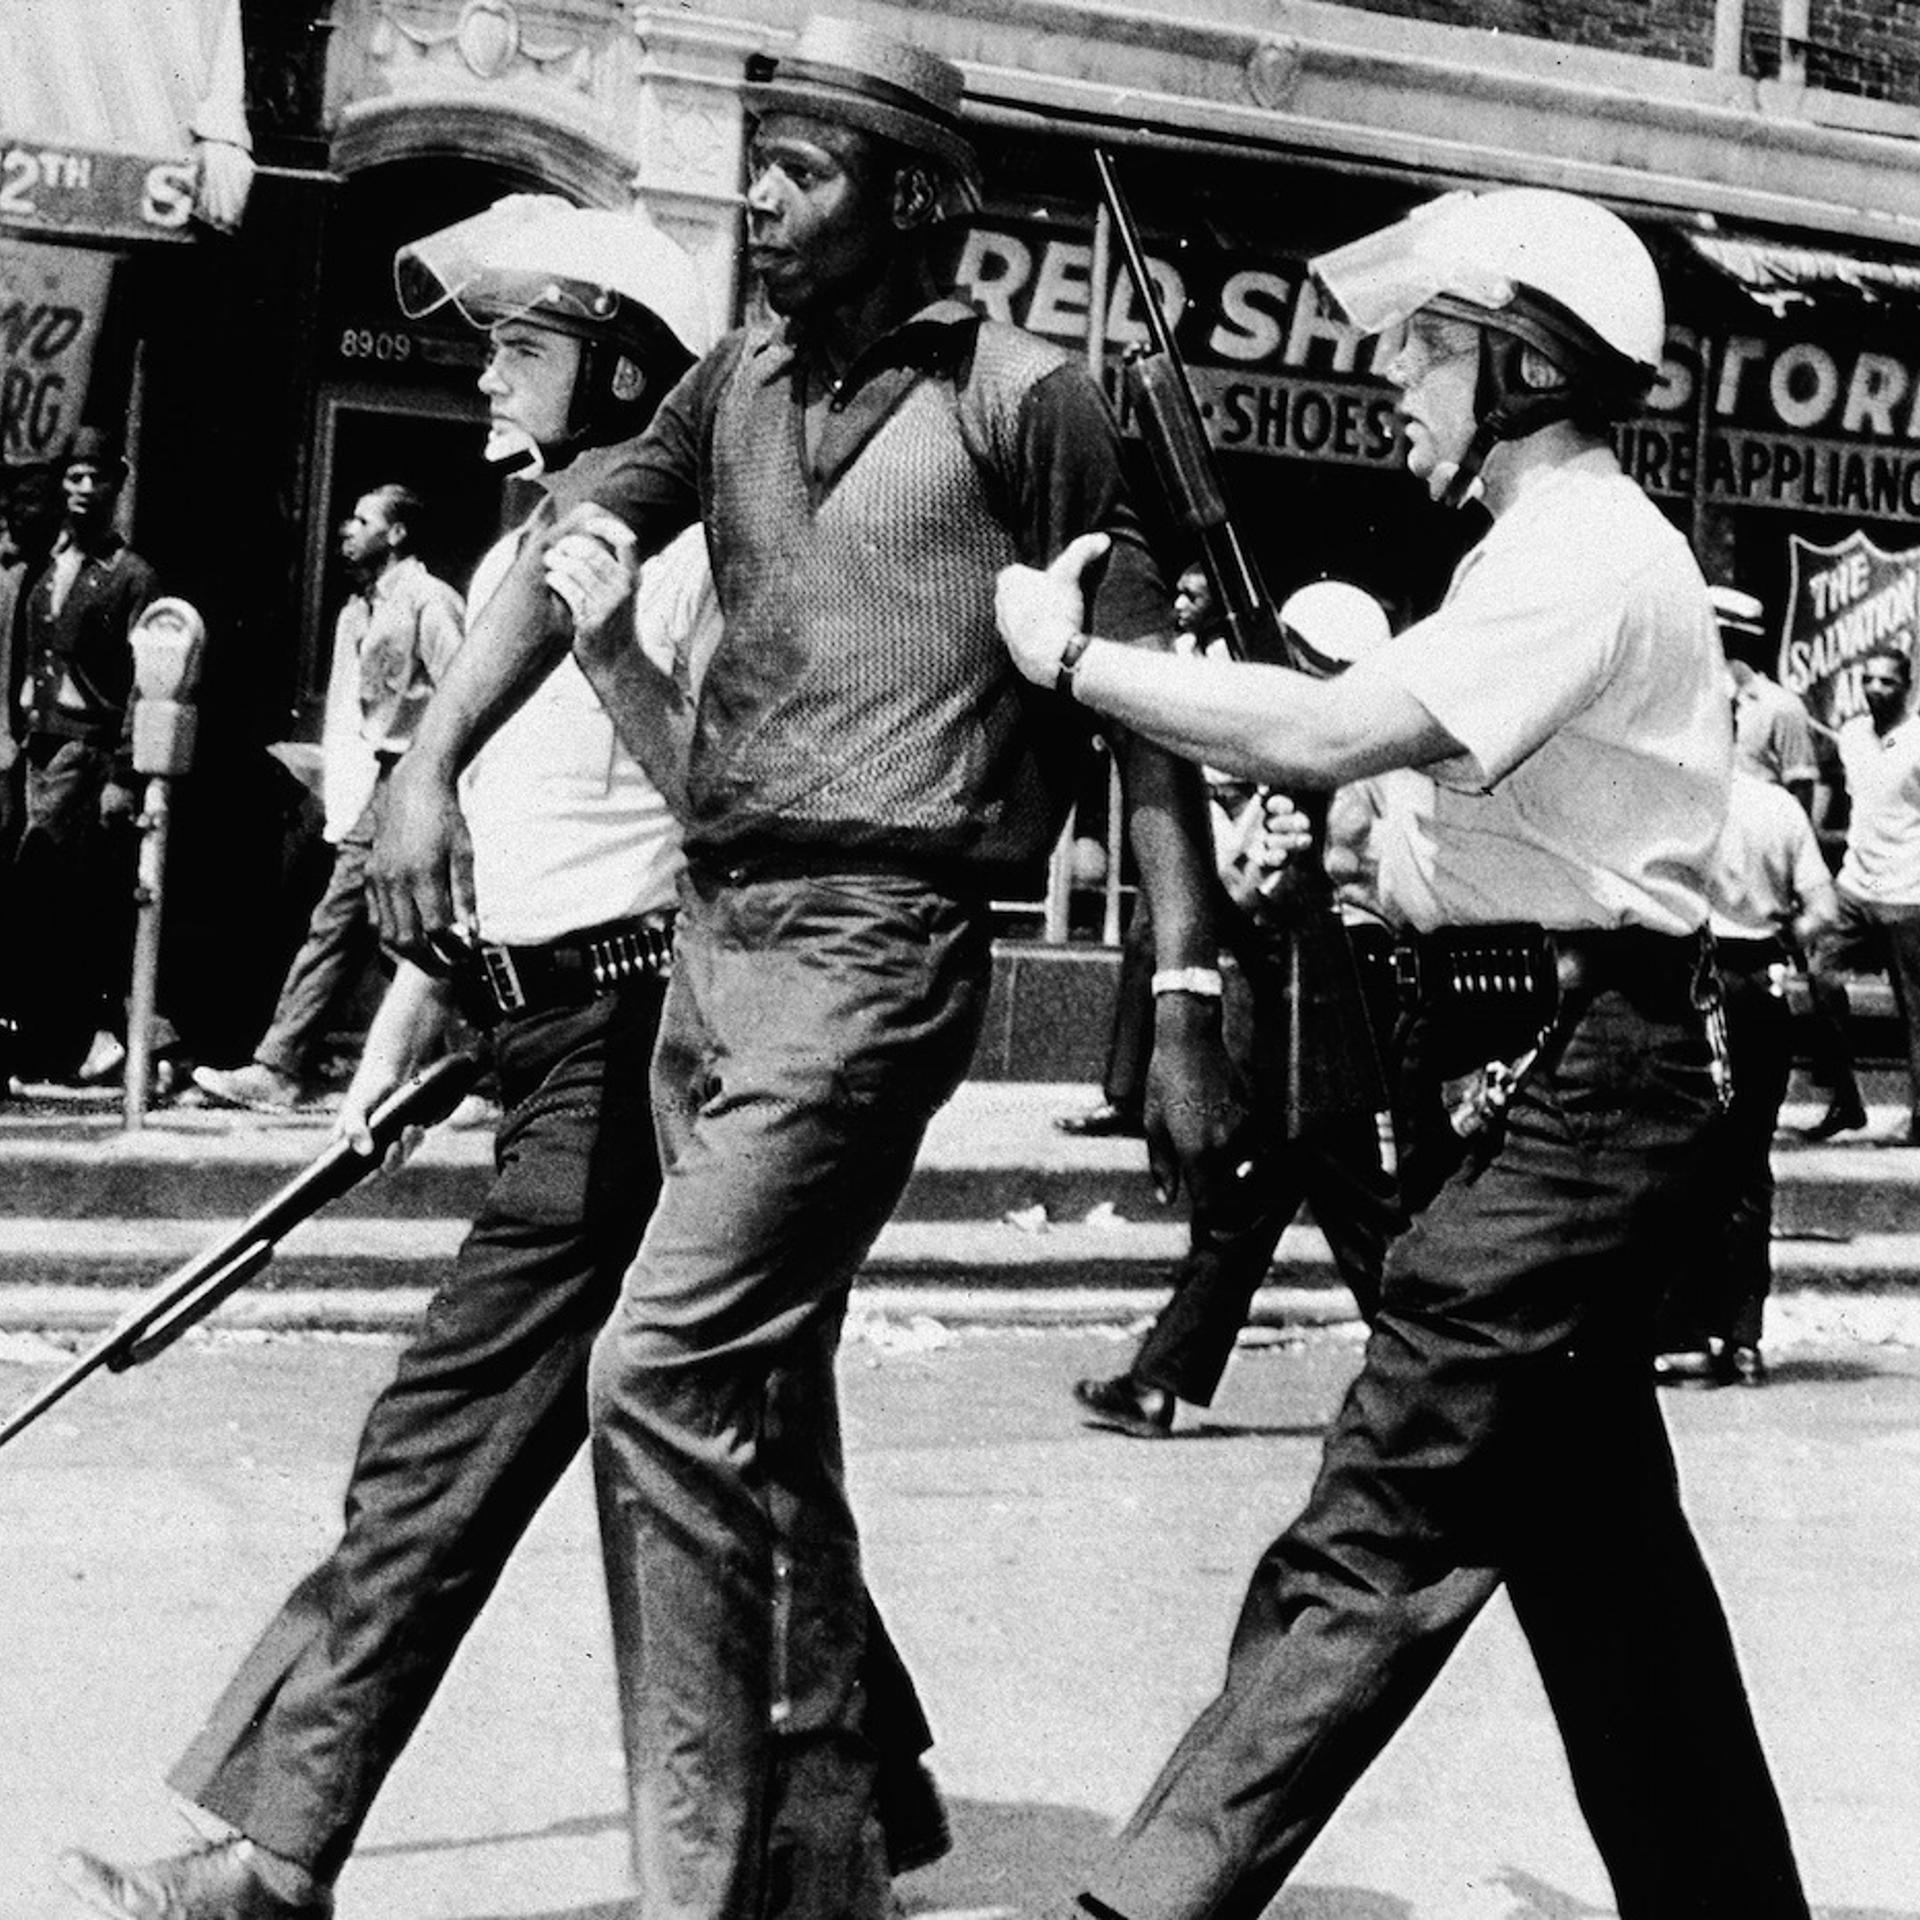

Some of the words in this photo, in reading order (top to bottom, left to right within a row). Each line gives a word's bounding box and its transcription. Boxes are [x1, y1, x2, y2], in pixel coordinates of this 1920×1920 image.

[955, 228, 1186, 343] RED
[340, 328, 412, 362] 8909
[1222, 384, 1396, 459] SHOES
[1809, 553, 1870, 620] THE
